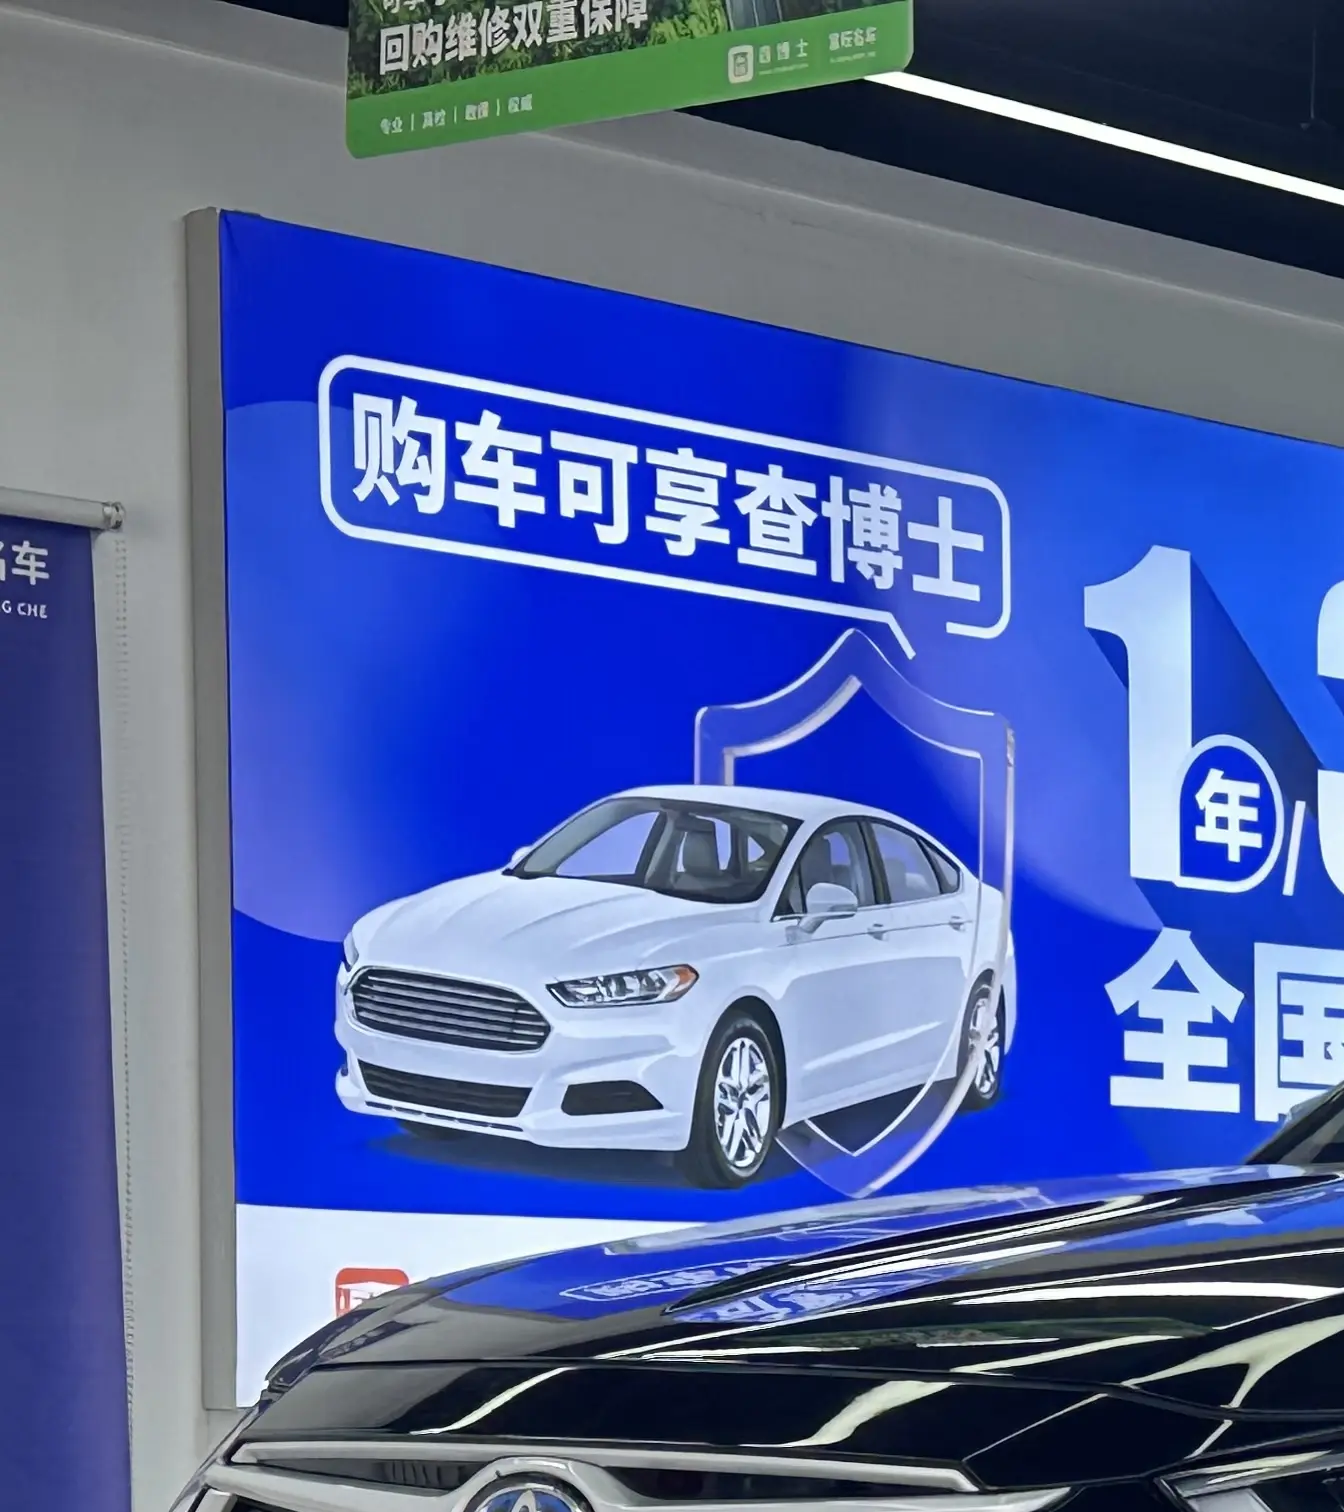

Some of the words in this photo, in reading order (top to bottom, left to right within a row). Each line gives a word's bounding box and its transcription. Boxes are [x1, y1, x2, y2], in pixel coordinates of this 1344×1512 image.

[379, 0, 648, 75] 回购维修双重保障
[353, 394, 983, 602] 购车可享查博士
[0, 540, 50, 586] 车
[17, 602, 49, 619] CHE
